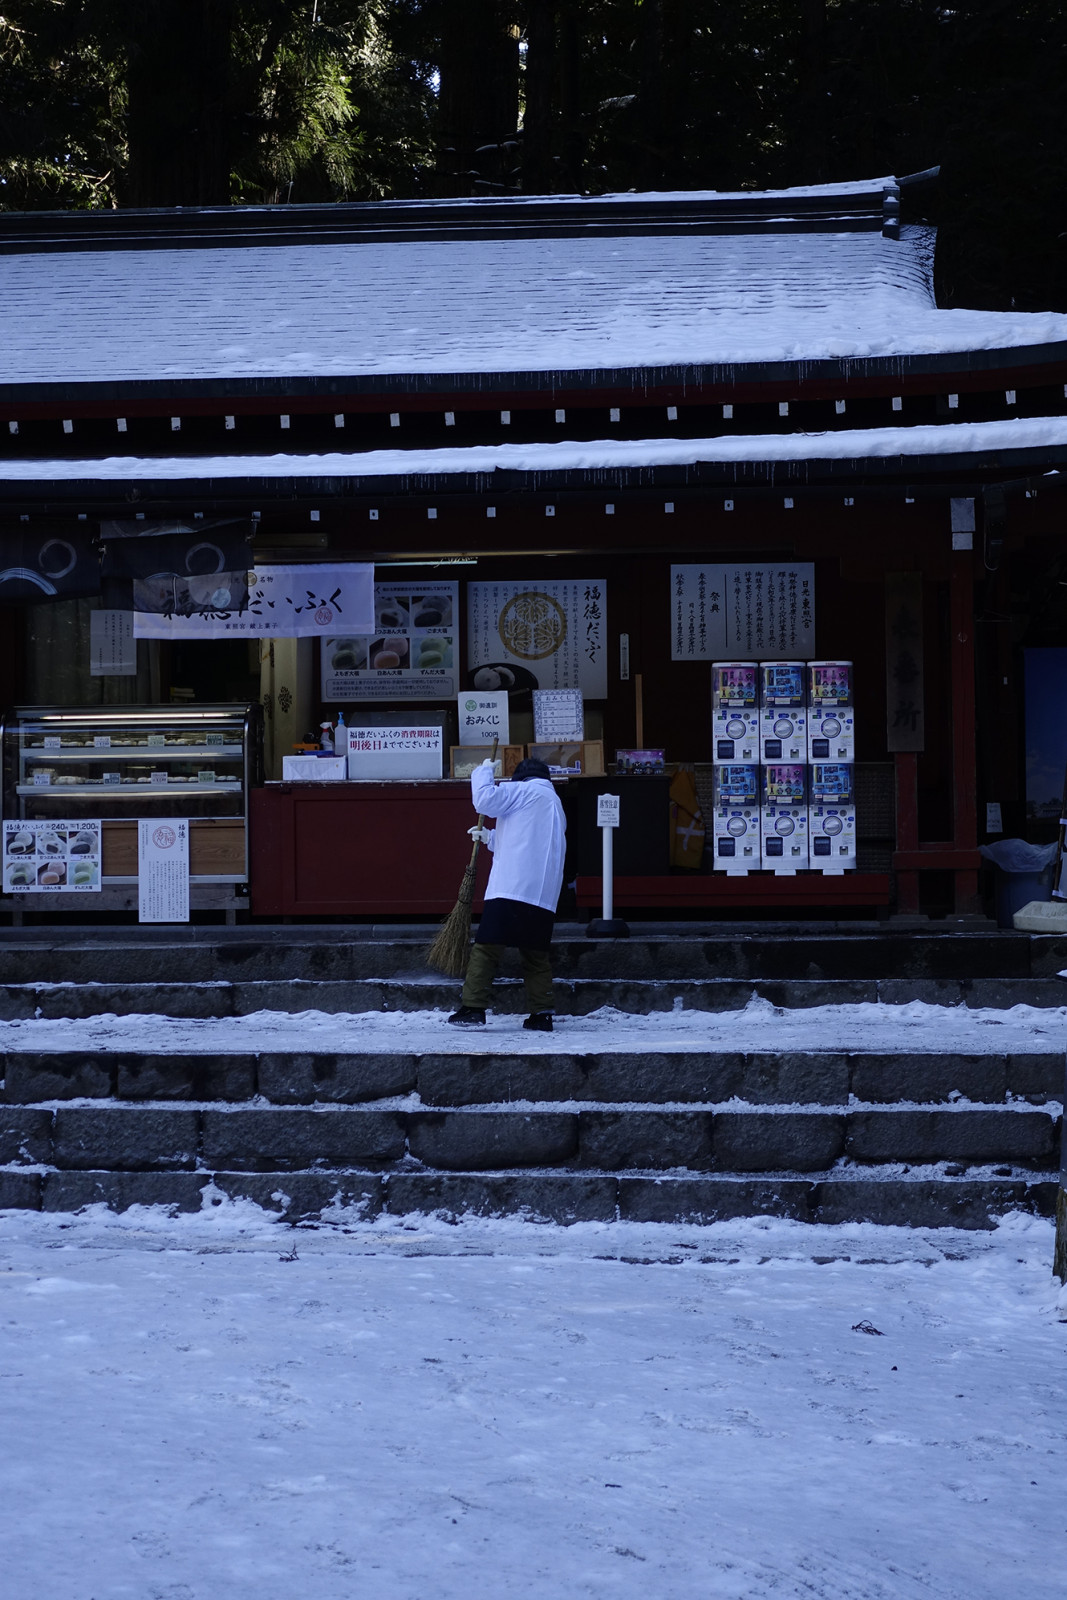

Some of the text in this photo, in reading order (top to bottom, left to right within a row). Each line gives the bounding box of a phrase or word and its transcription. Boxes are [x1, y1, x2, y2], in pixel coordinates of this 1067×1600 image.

[709, 591, 720, 614] 祭典
[801, 580, 812, 629] 日光東照宮
[583, 585, 601, 664] 福徳だいふく
[465, 715, 500, 725] おみくじ
[350, 730, 440, 739] 福徳だいふくの消費期限は
[350, 740, 440, 751] 明後日まででございます
